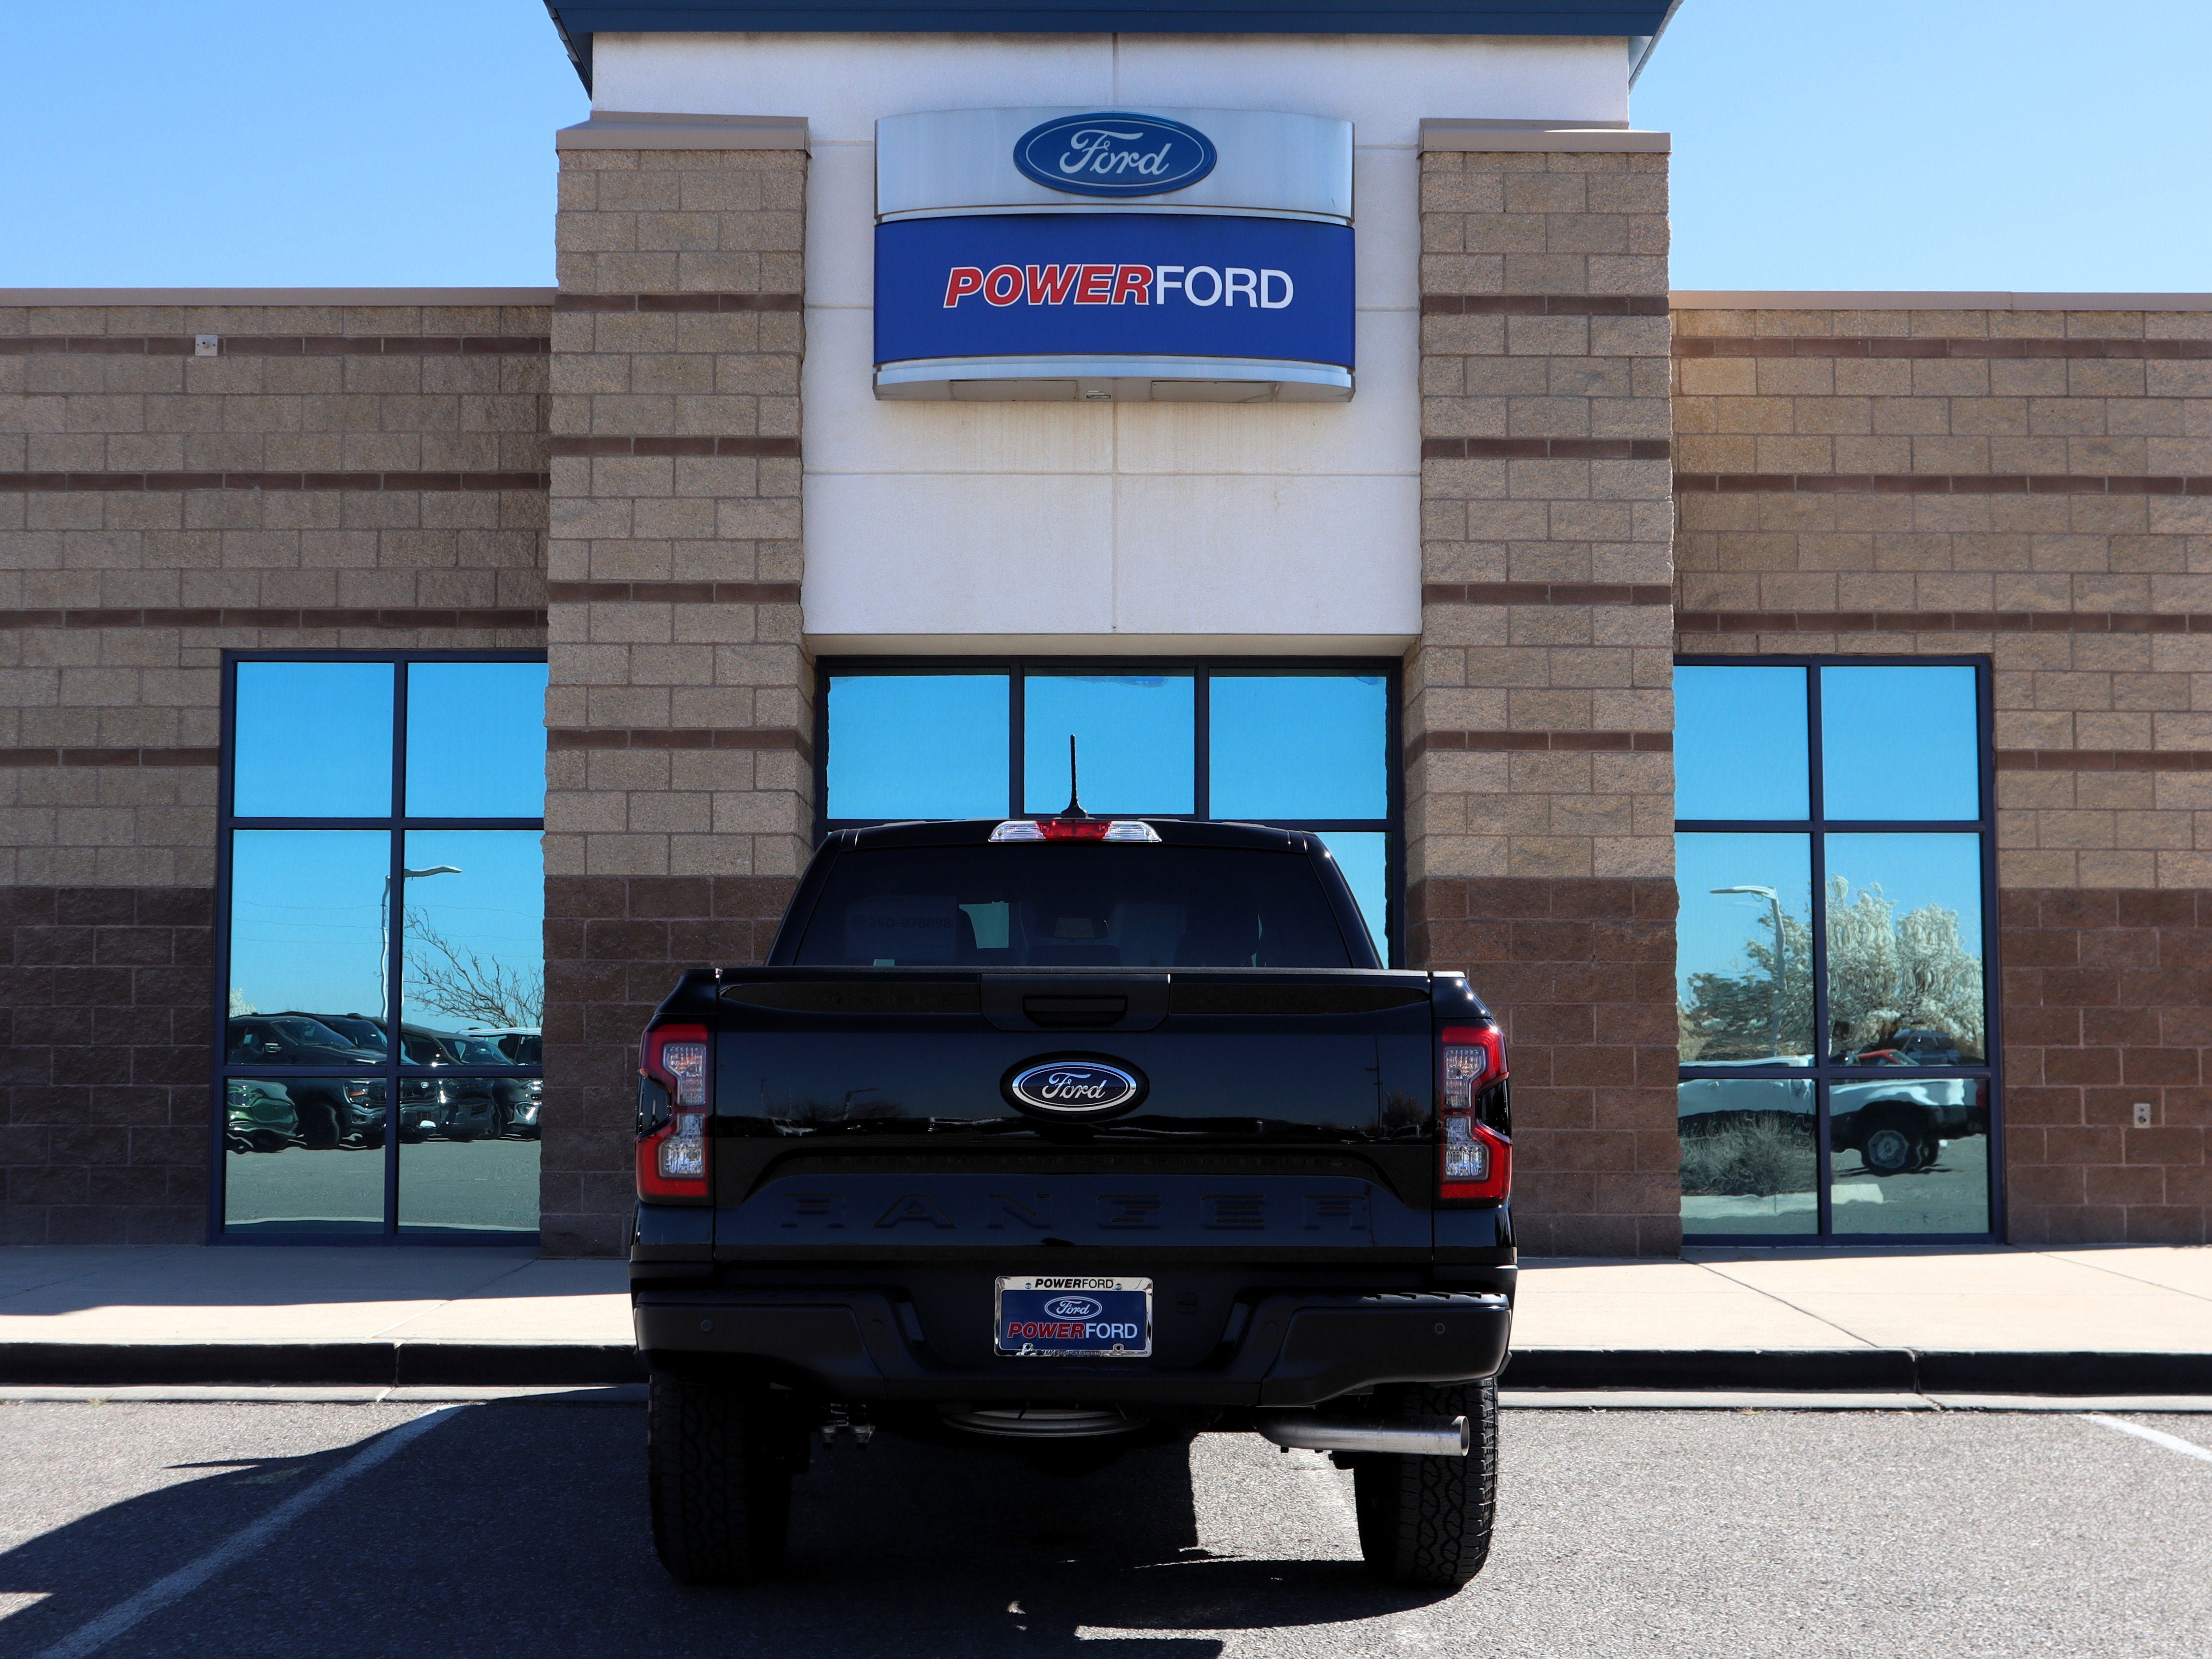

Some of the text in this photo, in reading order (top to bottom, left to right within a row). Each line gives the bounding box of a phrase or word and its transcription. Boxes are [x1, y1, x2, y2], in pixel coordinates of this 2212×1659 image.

[1059, 128, 1172, 176] Ford
[943, 264, 1294, 309] POWERFORD
[1041, 1072, 1107, 1099] Ford
[781, 1193, 1366, 1230] RANGER
[1034, 1278, 1114, 1289] POWERFORD
[1056, 1300, 1090, 1315] Ford
[1007, 1322, 1138, 1339] POWERFORD
